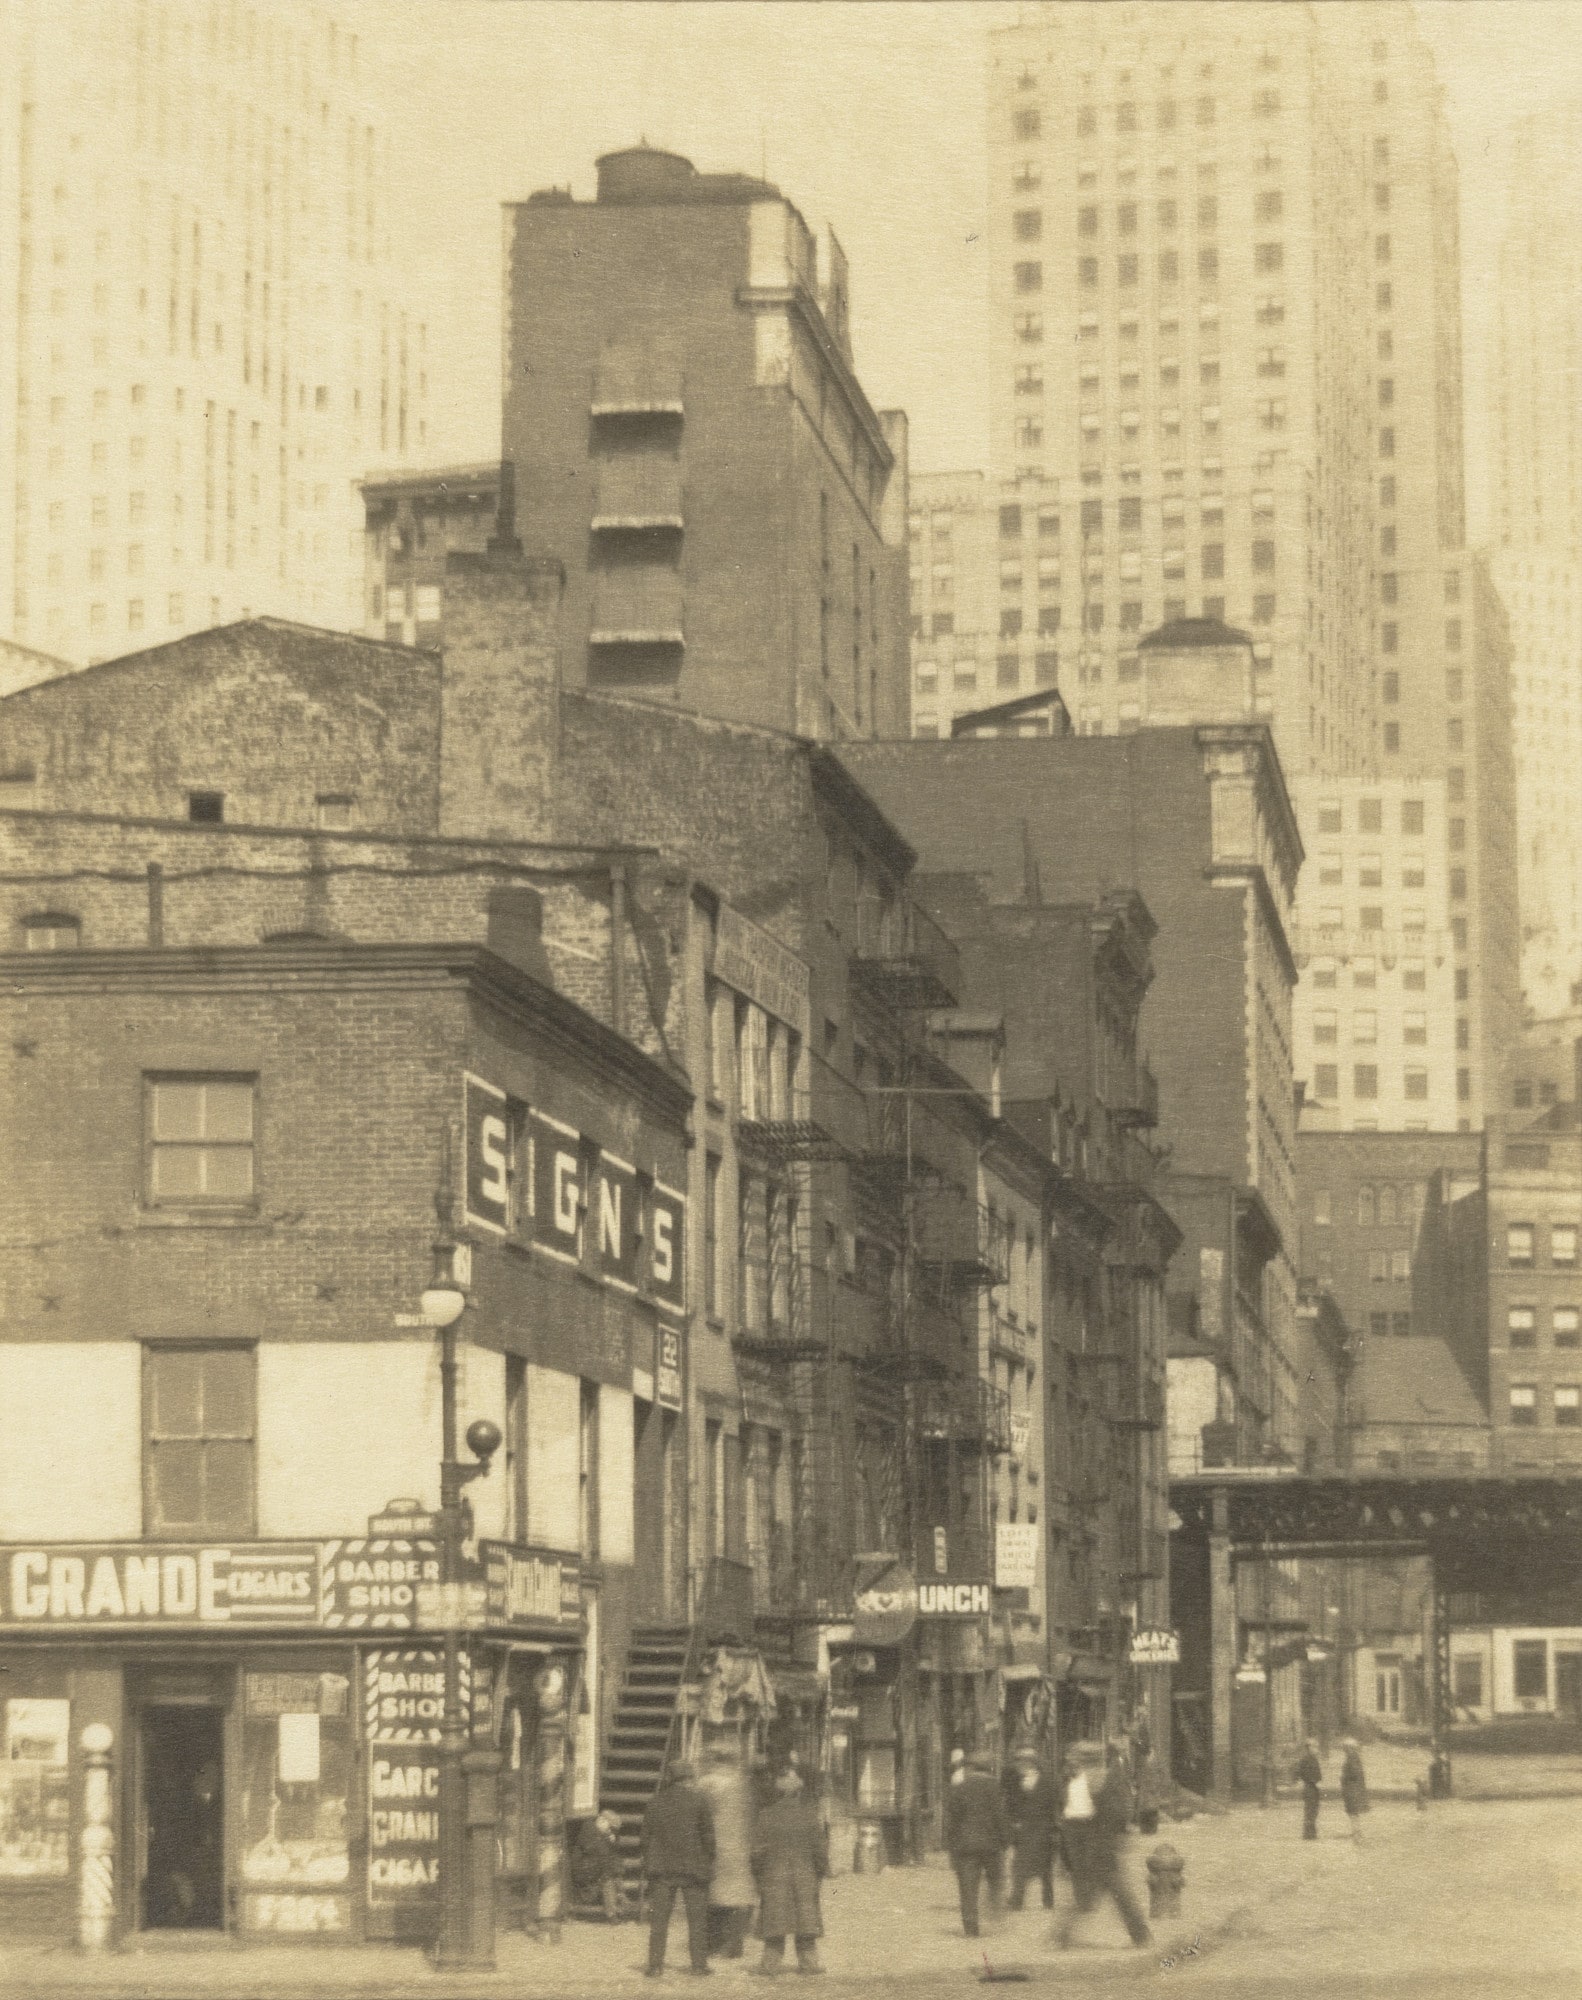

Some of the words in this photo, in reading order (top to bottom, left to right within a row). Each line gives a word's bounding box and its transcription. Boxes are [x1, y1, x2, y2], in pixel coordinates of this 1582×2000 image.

[480, 1113, 673, 1283] SIGNS
[10, 1549, 231, 1620] GRANDE
[228, 1569, 311, 1599] CIGARS
[336, 1559, 441, 1583] BARBER
[348, 1584, 414, 1608] SHO
[918, 1584, 990, 1612] UNCH
[378, 1671, 446, 1695] BARBE
[373, 1760, 440, 1799] GARC
[373, 1811, 440, 1847] GRAN
